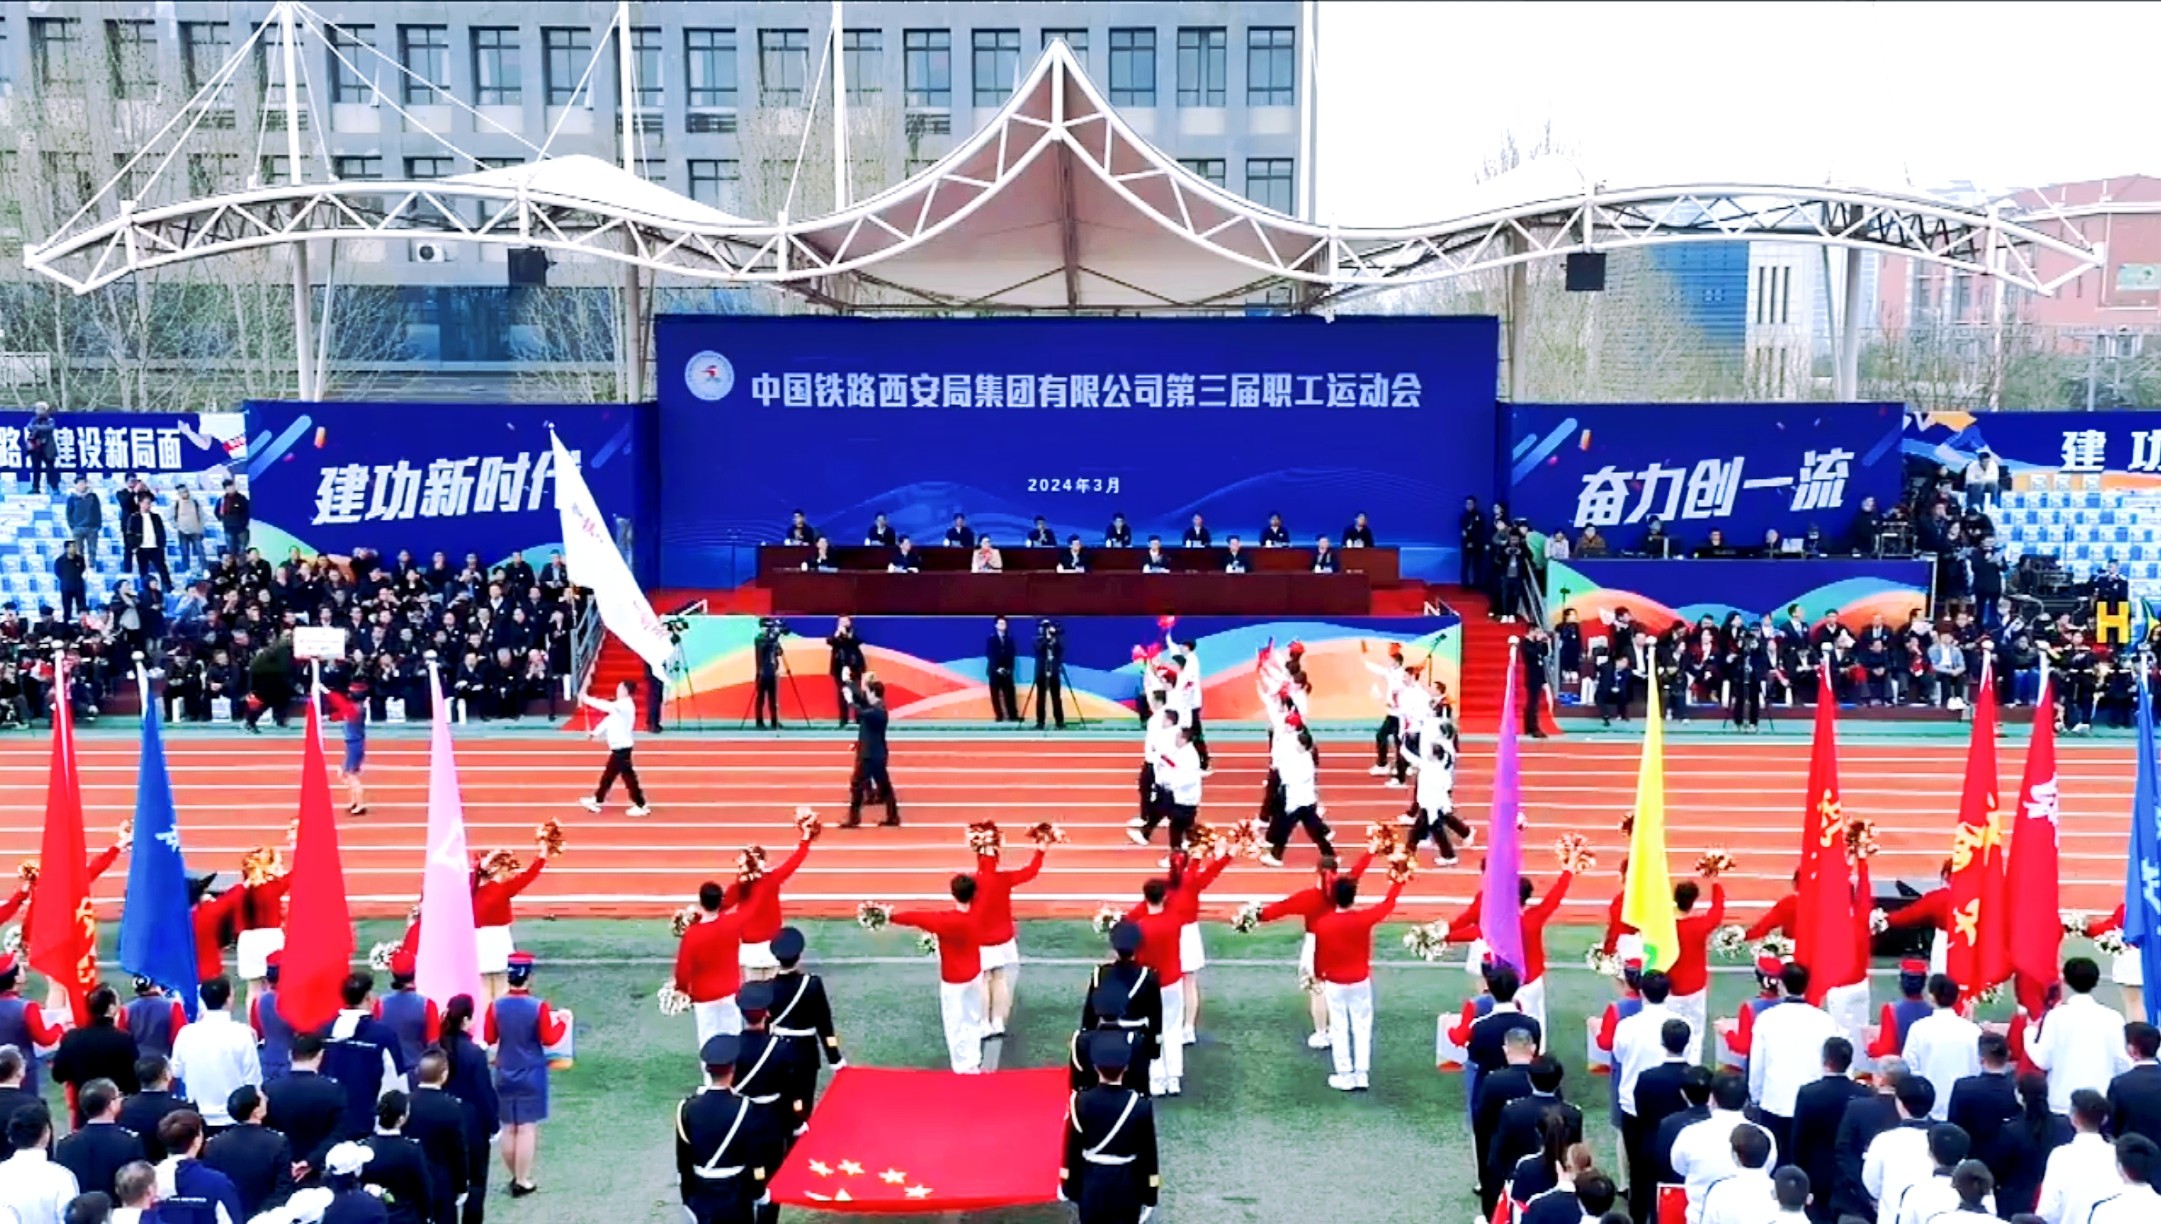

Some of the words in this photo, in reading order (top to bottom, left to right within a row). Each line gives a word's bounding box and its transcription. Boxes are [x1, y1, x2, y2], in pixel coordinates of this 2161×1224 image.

[752, 372, 1422, 408] 中国铁路西安局集团有限公司第三届职工运动会
[0, 426, 182, 469] 路建设新局面
[1027, 476, 1119, 494] 2024年3月
[1573, 447, 1855, 528] 奋力创一流
